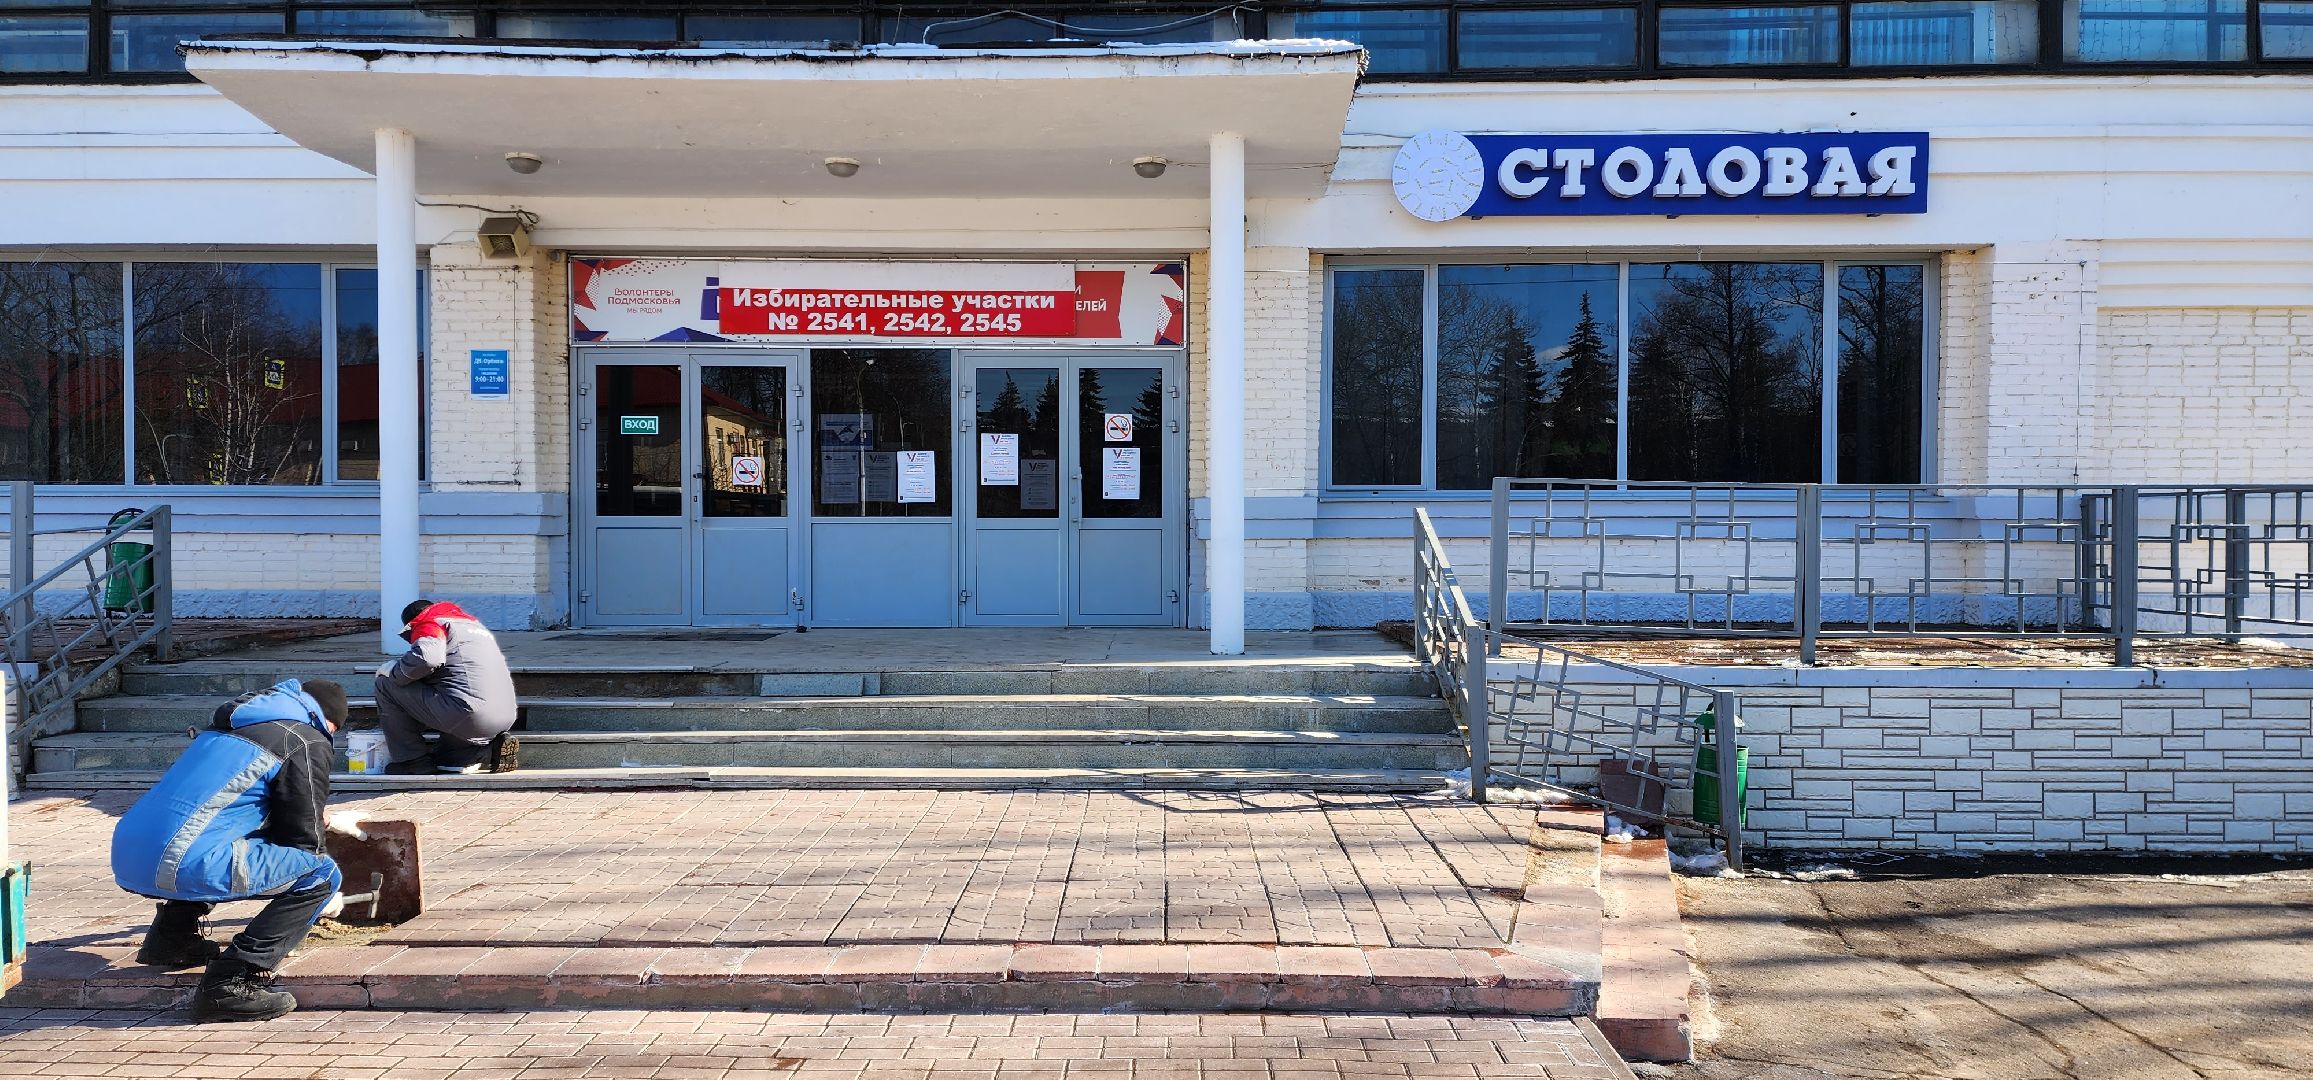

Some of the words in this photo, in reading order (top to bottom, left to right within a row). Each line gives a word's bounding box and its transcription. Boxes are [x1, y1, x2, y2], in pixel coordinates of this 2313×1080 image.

[1497, 145, 1917, 198] СТОЛОВАЯ
[732, 288, 945, 312] Избирательные
[951, 293, 1055, 314] участки
[768, 312, 799, 331] №
[806, 312, 876, 334] 2541,
[883, 313, 952, 335] 2542,
[960, 313, 1022, 332] 2545
[624, 419, 656, 431] ВХОД
